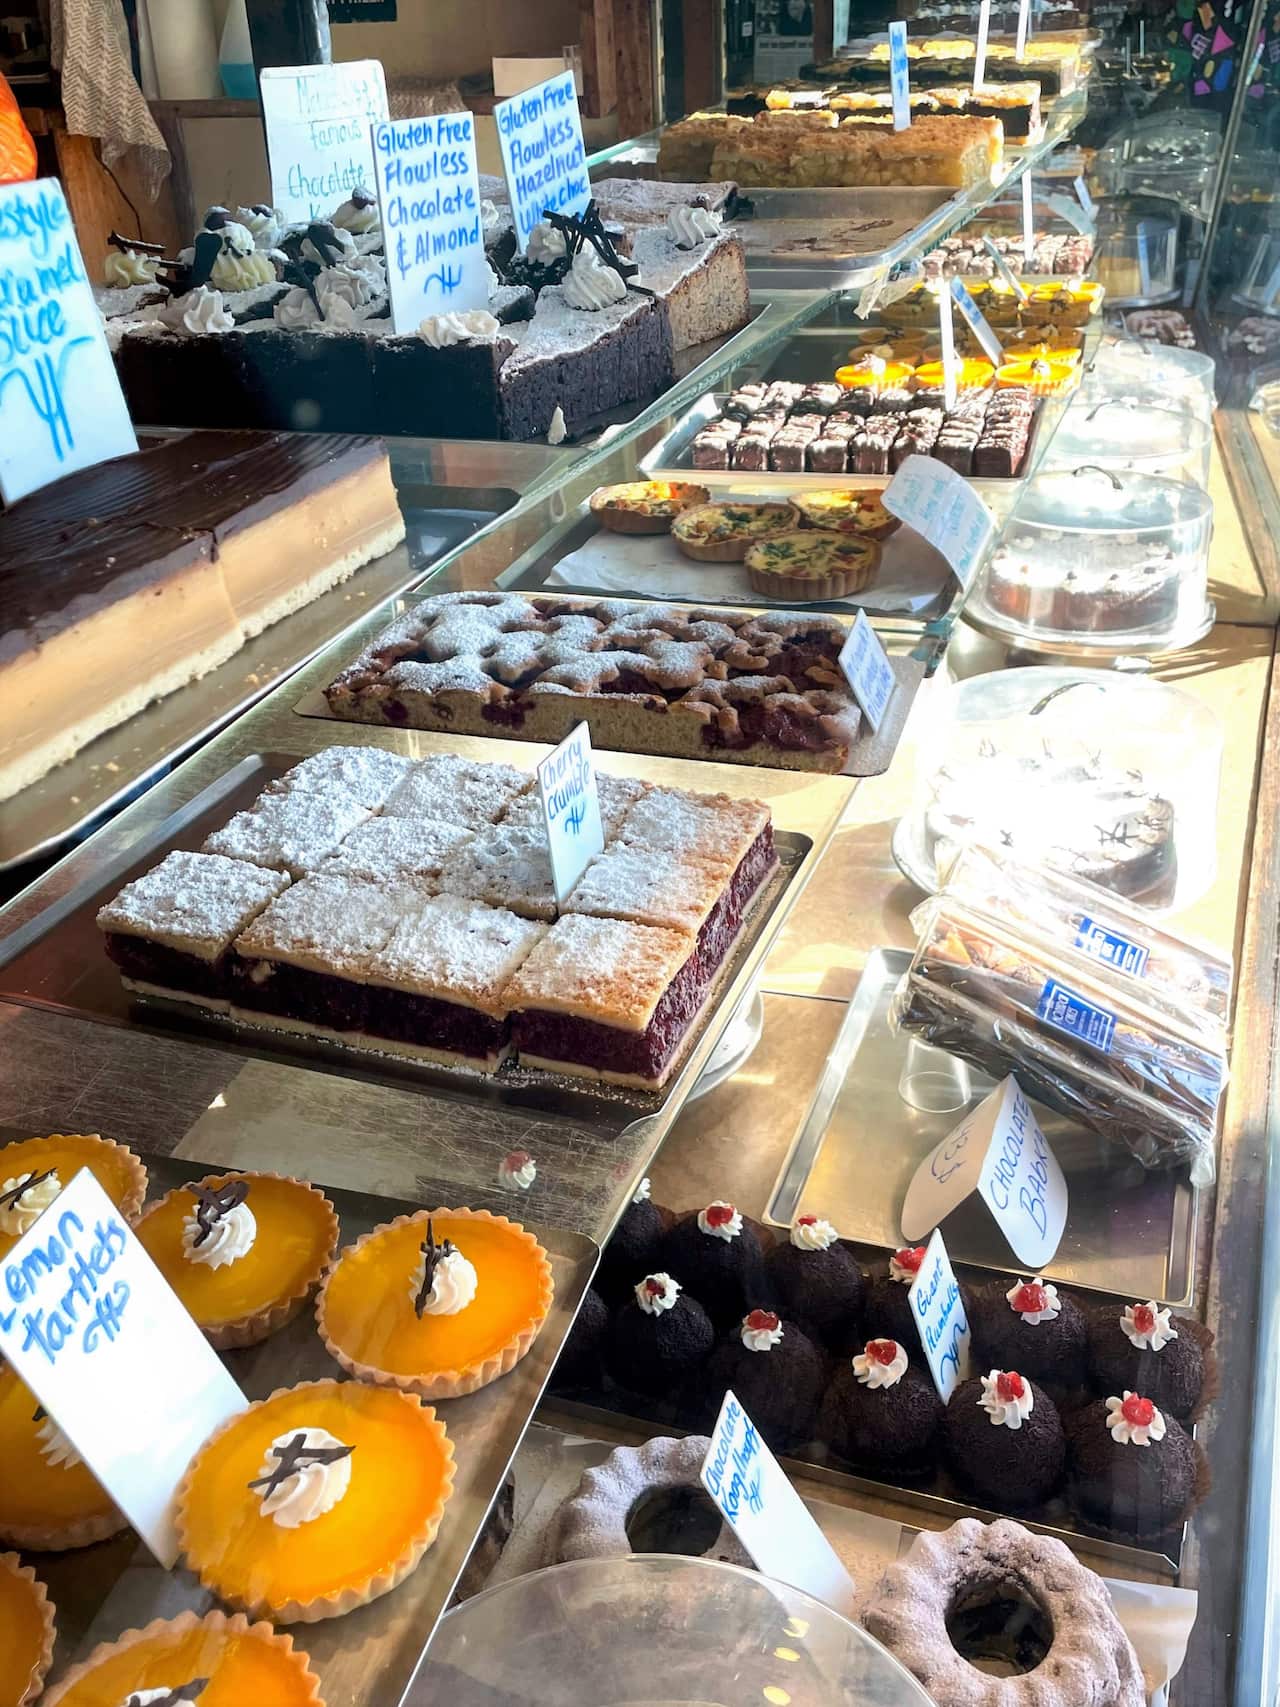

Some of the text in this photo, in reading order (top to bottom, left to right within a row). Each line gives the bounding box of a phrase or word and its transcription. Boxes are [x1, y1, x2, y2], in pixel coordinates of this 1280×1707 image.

[499, 80, 575, 137] Gluten Free
[376, 117, 472, 158] Gluten Free
[288, 157, 367, 199] Chocolate
[516, 137, 585, 206] Hazelnut
[388, 184, 476, 228] Chocolate
[415, 215, 480, 265] Almond
[543, 739, 583, 790] Cherry
[990, 1093, 1030, 1210] CHOCOLATE
[706, 1401, 741, 1497] Chocolate
